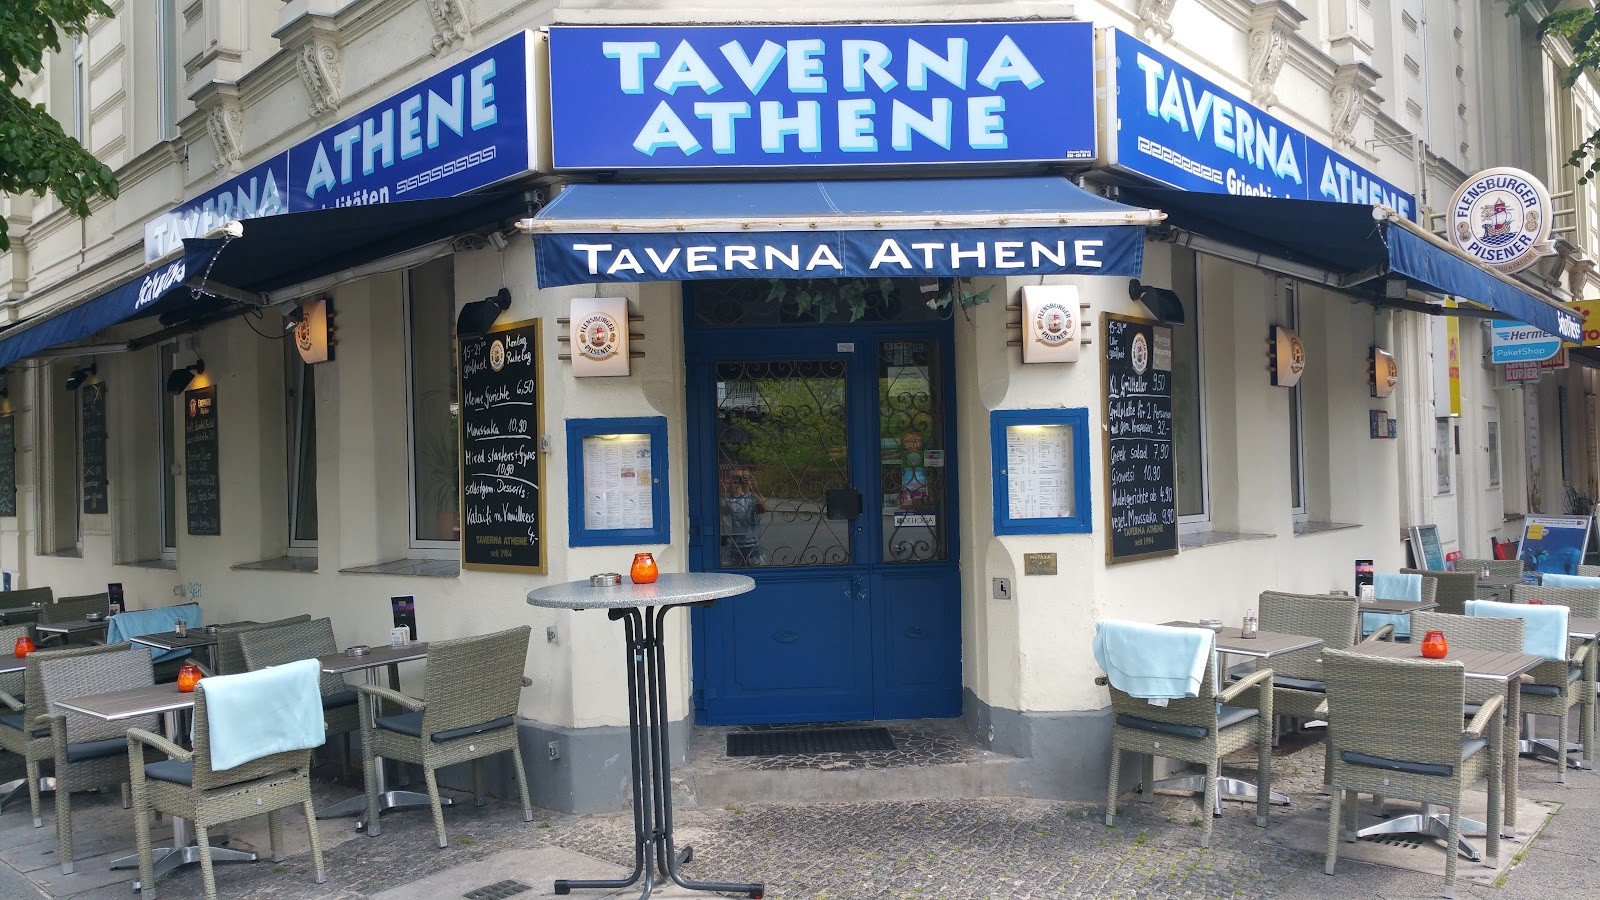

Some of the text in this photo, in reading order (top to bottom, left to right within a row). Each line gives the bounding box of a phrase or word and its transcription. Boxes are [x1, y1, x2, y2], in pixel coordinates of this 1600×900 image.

[602, 34, 1045, 96] TAVERNA
[632, 95, 1008, 156] ATHENE
[1137, 52, 1303, 185] TAVERNA
[306, 58, 498, 199] ATHENE
[1457, 177, 1537, 218] FLENSBURGER
[154, 168, 282, 256] TAVERNA
[1467, 234, 1532, 261] PILSENER
[572, 238, 1105, 275] TAVERNA ATHENE
[1037, 303, 1071, 319] FLENSBURGER
[505, 334, 527, 351] Montag
[1041, 330, 1069, 341] PILSENER
[1510, 330, 1553, 340] Herme
[585, 344, 612, 355] PILSENER
[1497, 347, 1546, 357] PaketShop
[516, 379, 535, 396] 6,50
[1146, 402, 1152, 419] 2
[466, 417, 528, 439] Moussaka 10,90
[1110, 445, 1126, 465] Greek
[1153, 444, 1169, 461] 7,90
[495, 463, 515, 476] 10,90
[1143, 464, 1161, 481] 10,90
[1123, 524, 1164, 537] TAVERNA ATHENE
[475, 535, 528, 546] TAVERNA ATHENE
